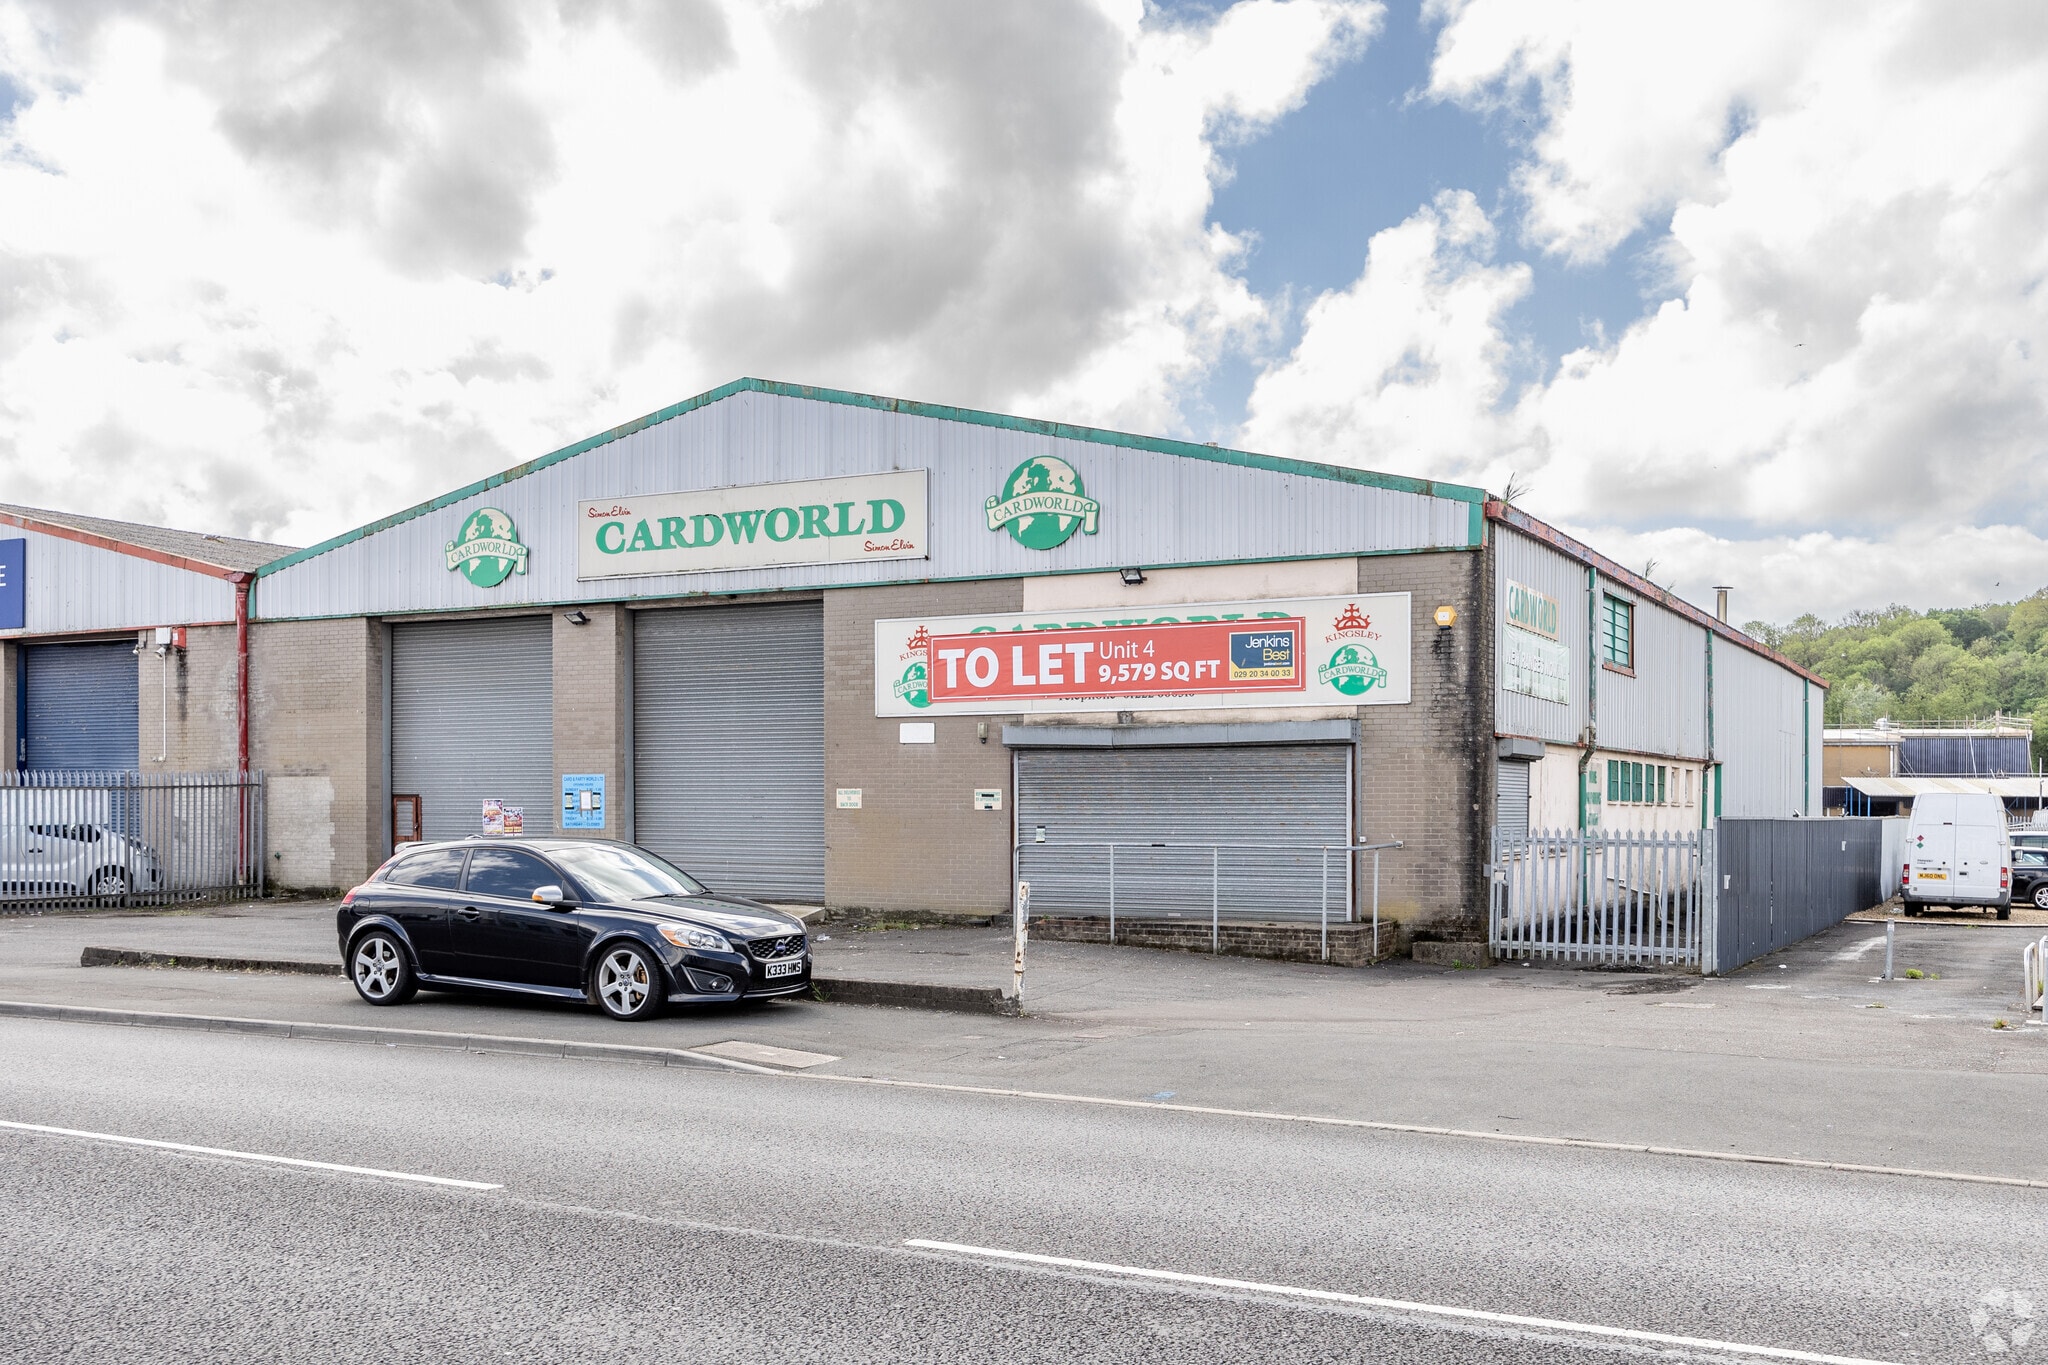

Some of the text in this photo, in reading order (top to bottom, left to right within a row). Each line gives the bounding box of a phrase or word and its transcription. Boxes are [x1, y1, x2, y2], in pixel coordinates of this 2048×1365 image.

[588, 506, 631, 518] Simon Elvin
[993, 496, 1084, 522] CARDWORLD
[596, 499, 905, 554] CARDWORLD
[450, 541, 517, 563] CARDWORLD
[864, 538, 914, 552] Simon Elvin
[1245, 634, 1290, 648] Jenkins
[1325, 629, 1382, 643] KINGSLEY
[899, 649, 928, 661] KINGS
[1100, 640, 1155, 659] Unit 4
[1263, 648, 1290, 661] Best
[938, 642, 1094, 688] TO LET
[1098, 659, 1220, 684] 9,579 SQ FT
[1233, 670, 1247, 678] 029
[1249, 670, 1258, 678] 20
[1270, 669, 1280, 677] 00
[1281, 669, 1291, 677] 33
[1323, 665, 1378, 680] CARDWORLD
[897, 680, 928, 694] CARDWO
[767, 964, 786, 976] K333
